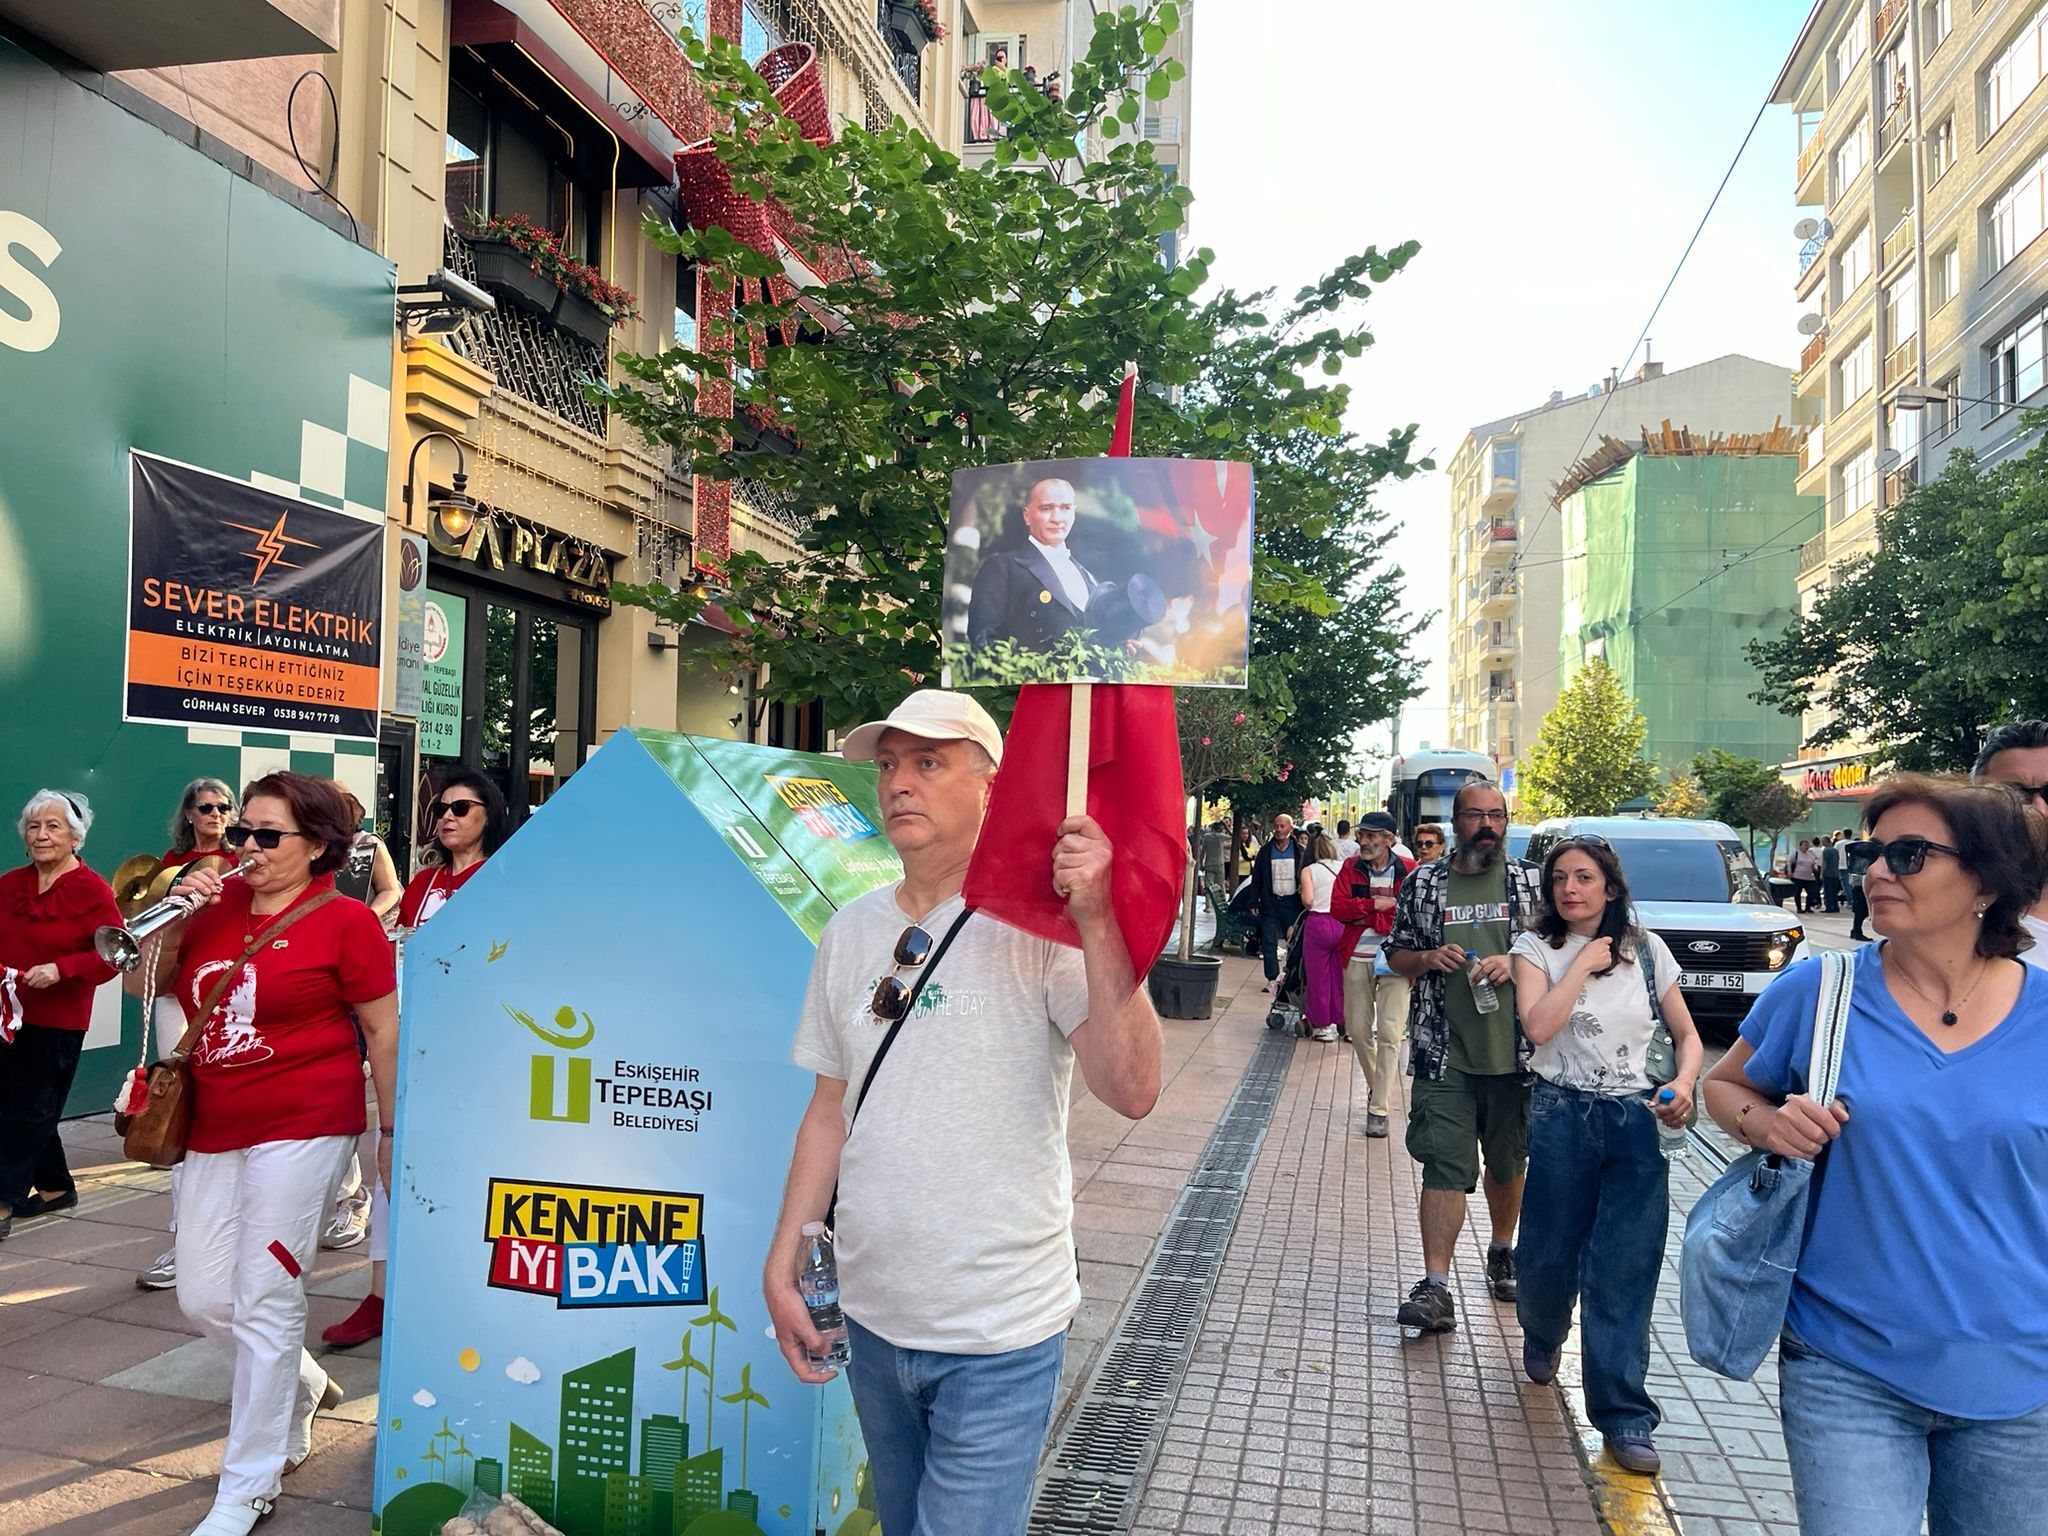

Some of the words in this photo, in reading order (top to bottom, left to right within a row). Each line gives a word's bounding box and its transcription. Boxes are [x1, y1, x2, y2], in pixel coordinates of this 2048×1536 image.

[512, 526, 611, 590] PLAZA
[143, 577, 245, 623] SEVER
[255, 599, 373, 646] ELEKTRİK
[176, 620, 253, 643] ELEKTRİK
[264, 635, 349, 658] AYDINLATMA
[181, 646, 214, 663] BİZİ
[219, 652, 274, 671] TERCİH
[279, 661, 345, 682] ETTİĞİNİZ
[433, 665, 456, 677] TEPEBAŞI
[177, 666, 212, 687] İÇİN
[218, 674, 294, 695] TEŞEKKÜR
[298, 684, 345, 701] EDERİZ
[433, 679, 460, 698] GÜZELLİK
[182, 698, 230, 713] GÜRHAN
[232, 703, 266, 717] SEVER
[274, 708, 296, 720] 0538
[299, 710, 315, 722] 947
[315, 711, 328, 722] 77
[328, 713, 340, 724] 78
[436, 702, 458, 717] KURSU
[434, 722, 444, 735] 42
[444, 723, 454, 736] 99
[1451, 905, 1474, 920] TOP
[1475, 903, 1503, 919] GUN
[1695, 974, 1714, 986] ABF
[1722, 975, 1742, 987] 152
[929, 995, 953, 1016] THE
[960, 995, 987, 1016] DAY
[613, 1060, 700, 1084] ESKİŞEHİR
[595, 1078, 713, 1116] TEPEBAŞI
[612, 1111, 699, 1133] BELEDİYESİ
[502, 1192, 690, 1250] KENTİNE
[567, 1242, 697, 1298] BAK!
